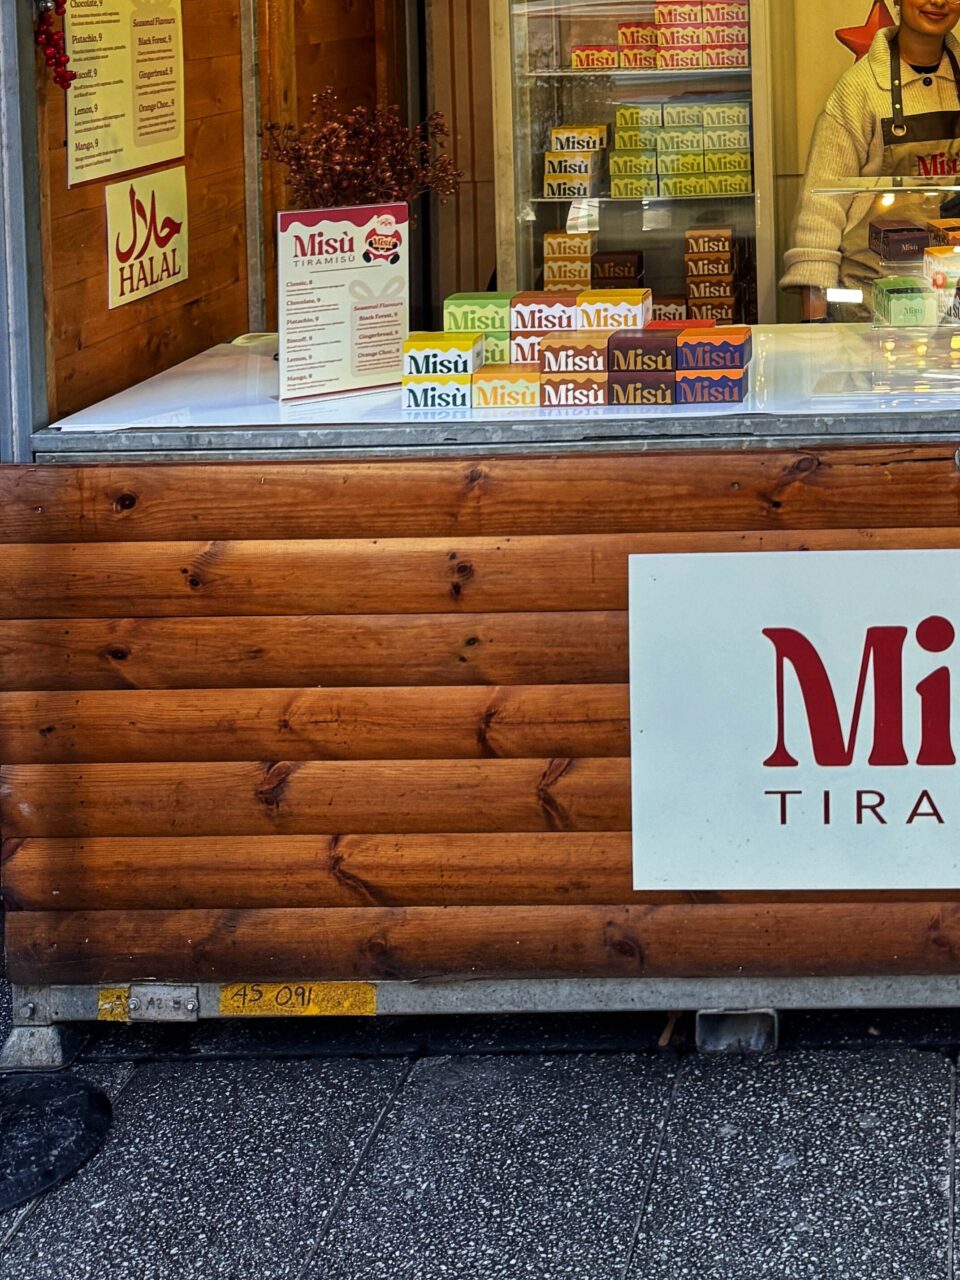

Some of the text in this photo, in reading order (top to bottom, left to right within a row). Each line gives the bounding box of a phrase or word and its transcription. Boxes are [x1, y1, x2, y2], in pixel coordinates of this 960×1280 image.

[658, 8, 698, 23] Misù
[705, 6, 746, 21] Misù
[660, 30, 700, 45] Misù
[705, 29, 746, 44] Misù
[575, 53, 615, 67] Misù
[660, 53, 700, 67] Misù
[705, 51, 746, 66] Misù
[555, 135, 597, 150] Misù
[548, 159, 588, 174] Misù
[546, 182, 587, 197] Misù
[293, 230, 355, 258] Misù
[547, 241, 588, 256] Misù
[688, 237, 729, 252] Misù
[293, 254, 355, 267] TIRAMISÙ
[688, 260, 729, 275] Misù
[118, 248, 181, 297] HALAL
[547, 264, 588, 279] Misù
[689, 282, 731, 298] Misù
[447, 310, 506, 330] Misù
[515, 308, 572, 329] Misù
[580, 308, 638, 328] Misù
[408, 353, 468, 374] Misù
[543, 349, 604, 372] Misù
[612, 348, 672, 370] Misù
[682, 345, 740, 368] Misù
[406, 386, 466, 408] Misù
[476, 385, 536, 406] Misù
[543, 383, 604, 405] Misù
[612, 382, 672, 404] Misù
[680, 380, 739, 402] Misù
